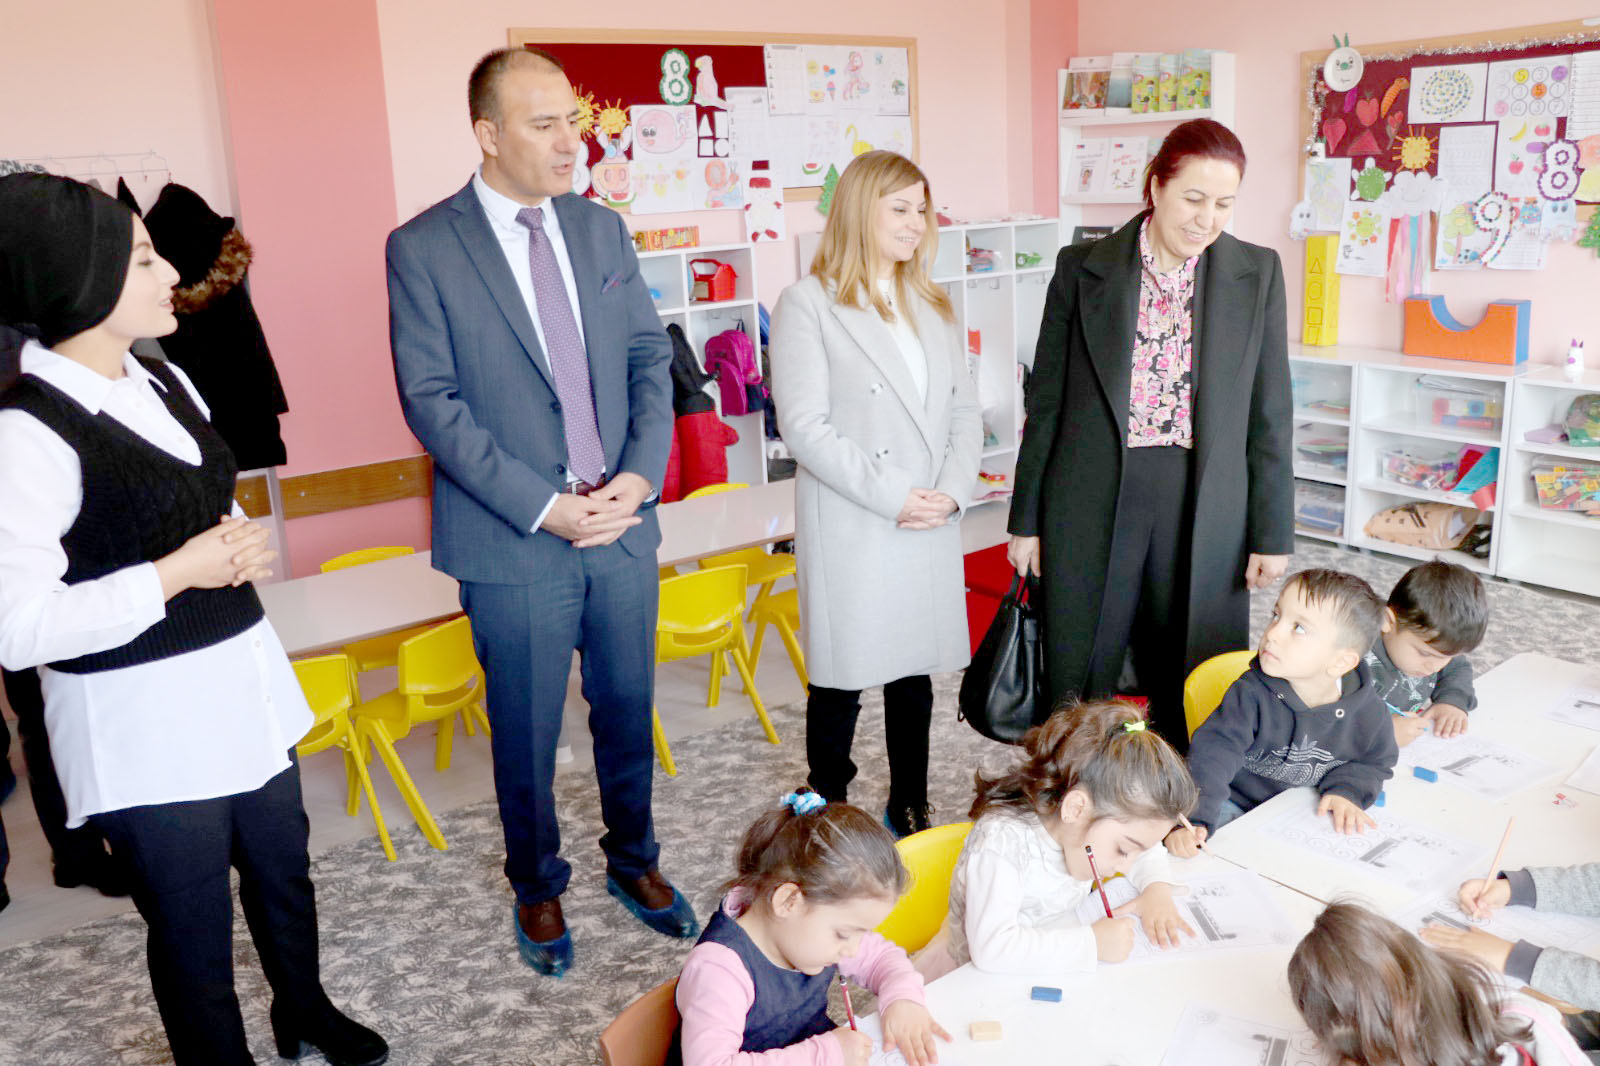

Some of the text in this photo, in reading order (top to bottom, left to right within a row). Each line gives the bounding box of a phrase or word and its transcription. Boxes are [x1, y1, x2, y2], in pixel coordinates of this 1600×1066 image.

[659, 48, 693, 106] 8
[1537, 139, 1580, 201] 8
[1469, 191, 1513, 267] 9
